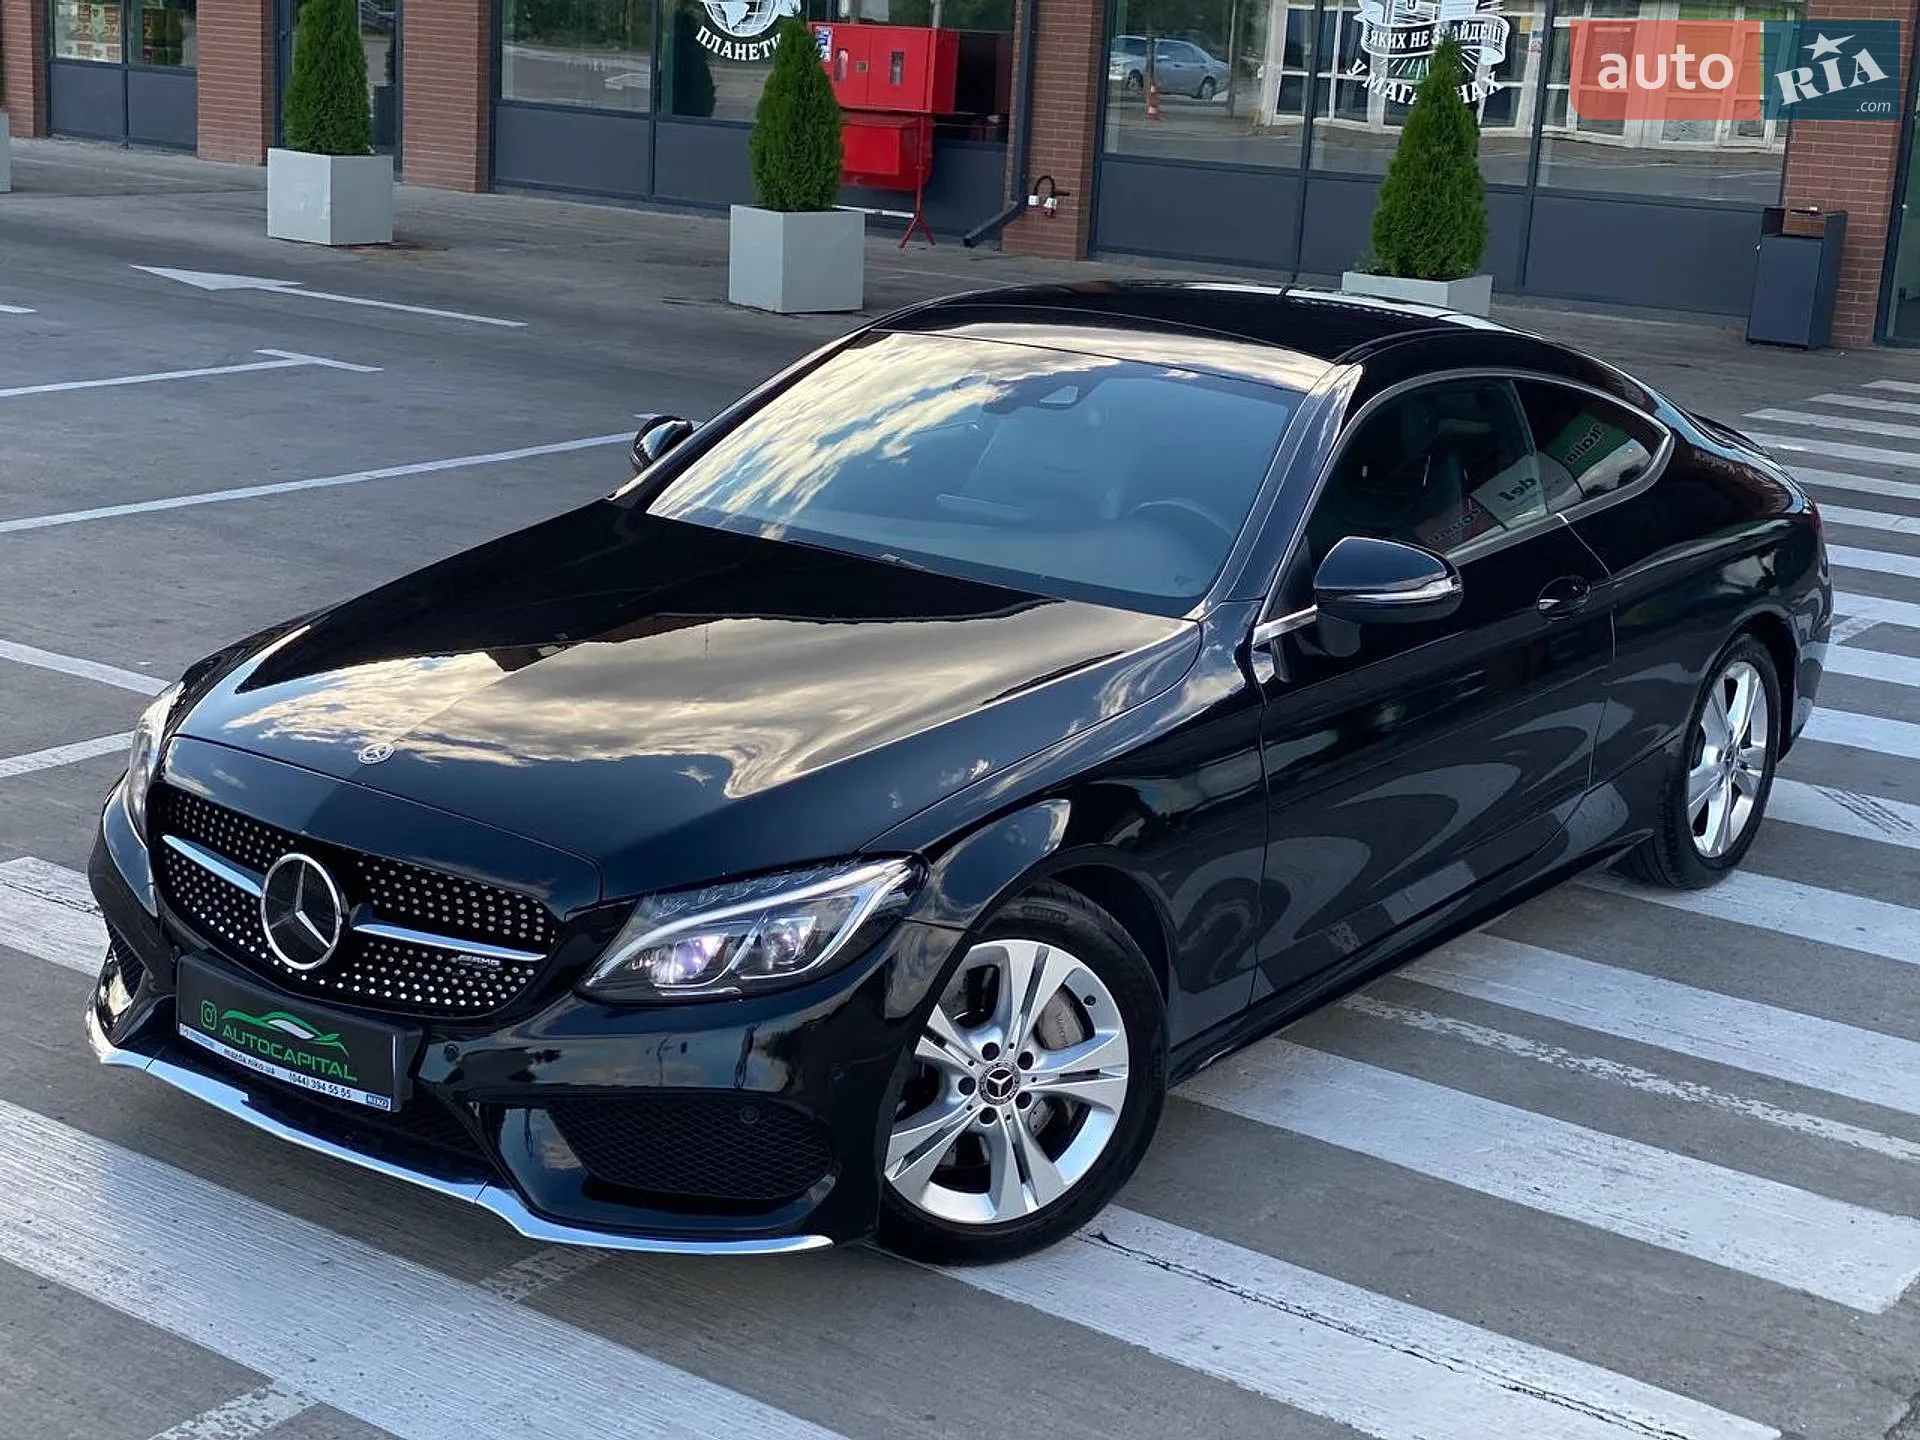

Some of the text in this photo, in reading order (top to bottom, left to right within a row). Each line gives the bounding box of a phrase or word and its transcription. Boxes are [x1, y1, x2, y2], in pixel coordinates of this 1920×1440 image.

[1369, 30, 1407, 49] ЯКИХ
[1409, 30, 1430, 48] НЕ
[1346, 58, 1367, 76] У
[221, 1023, 358, 1081] AUTOCAPITAL
[311, 1079, 327, 1092] 394
[328, 1084, 339, 1096] 55
[340, 1086, 352, 1099] 55
